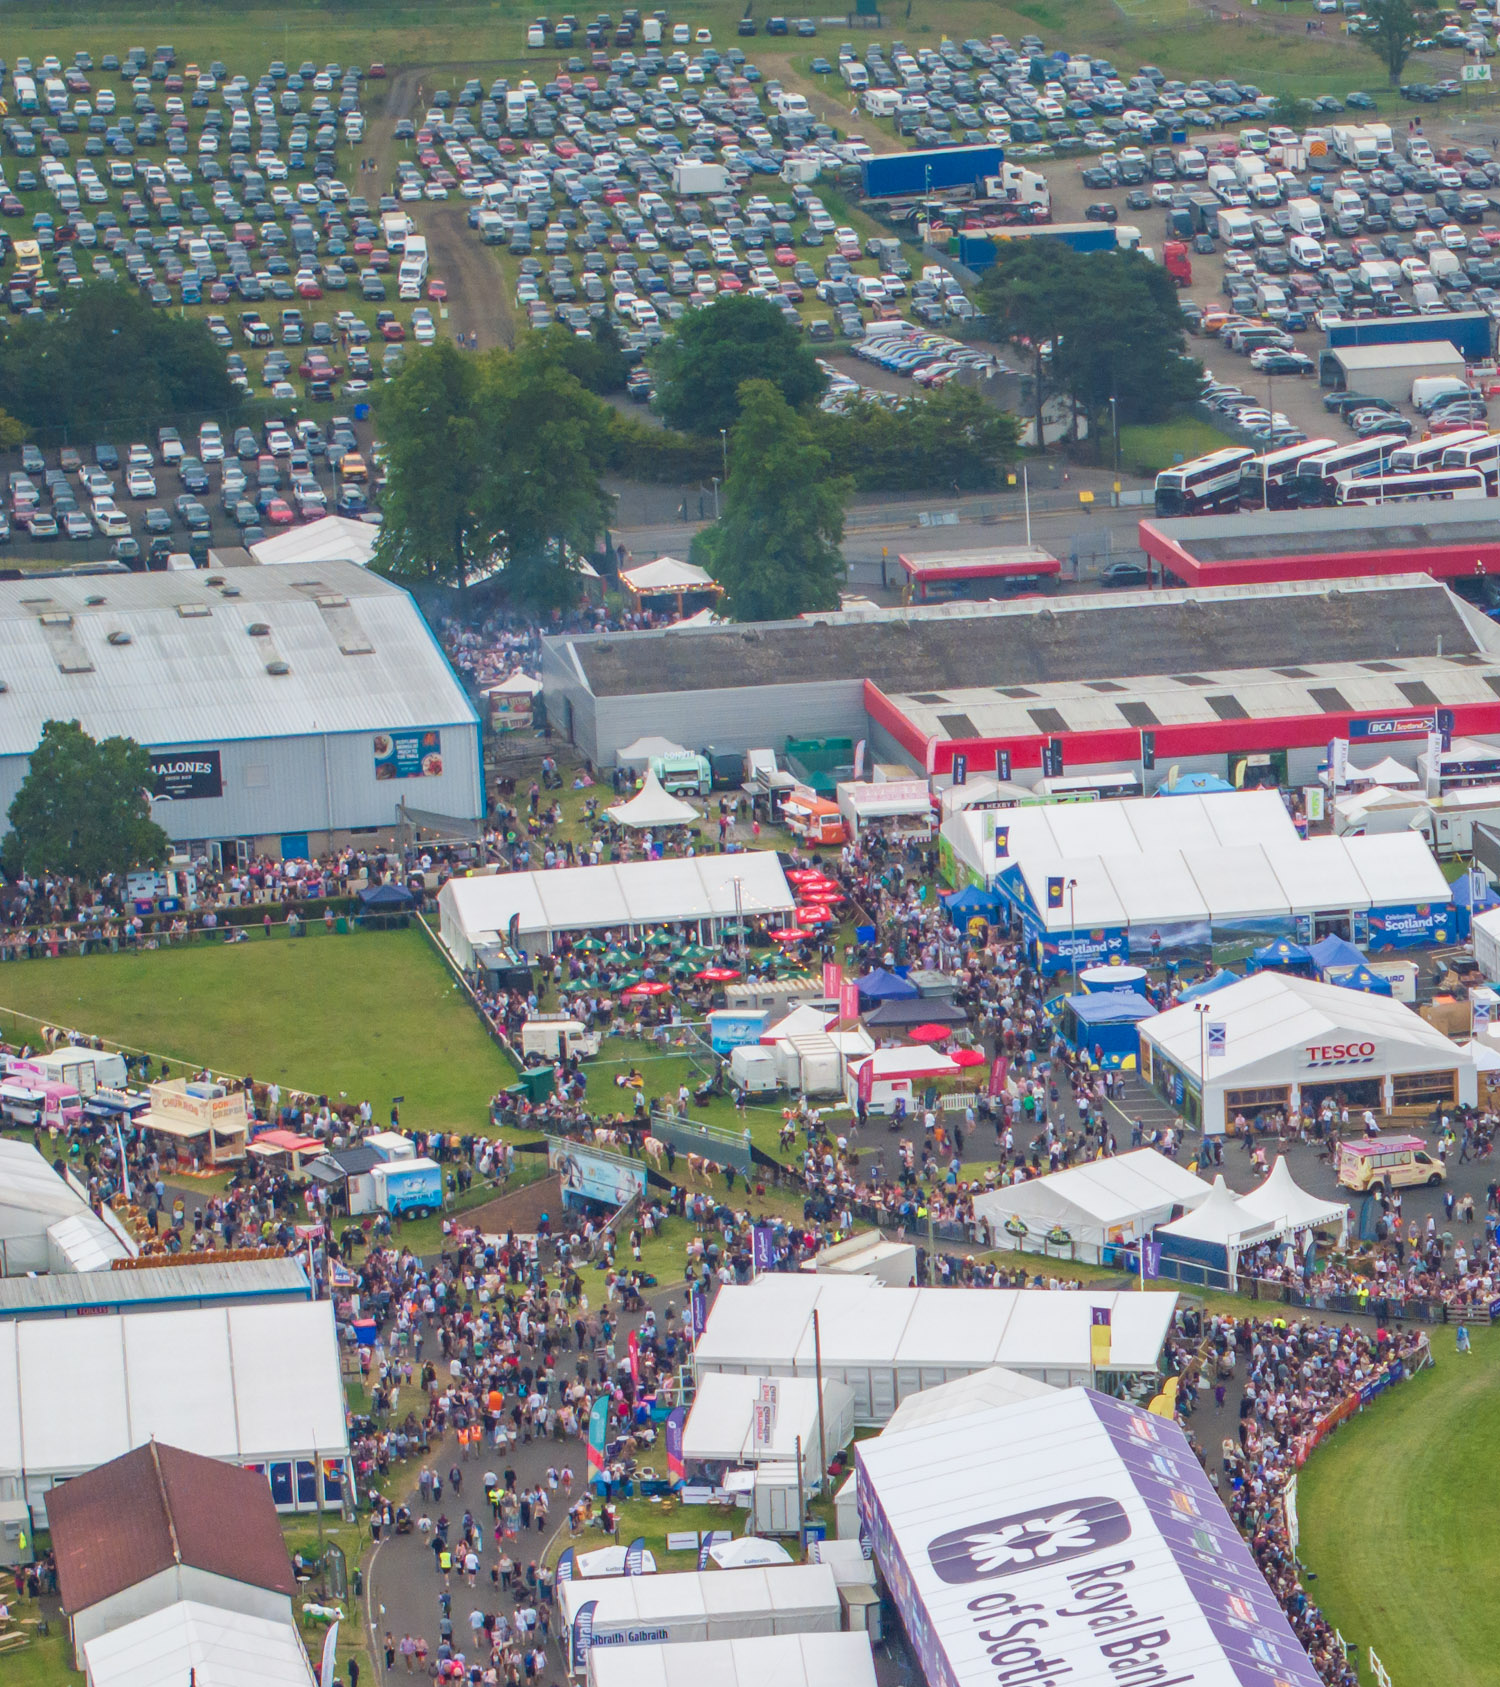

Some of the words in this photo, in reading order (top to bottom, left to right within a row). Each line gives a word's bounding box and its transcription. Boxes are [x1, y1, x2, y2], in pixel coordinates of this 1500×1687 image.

[1371, 720, 1393, 733] BCA
[1396, 719, 1425, 731] Scotland
[1385, 917, 1434, 932] Scotland
[1058, 942, 1107, 956] Scotland
[1384, 974, 1404, 983] AIRD
[1306, 1042, 1375, 1060] TESCO
[1056, 1559, 1165, 1635] Royal
[966, 1591, 1045, 1626] of
[590, 1631, 625, 1646] albraith
[628, 1629, 668, 1642] Galbraith
